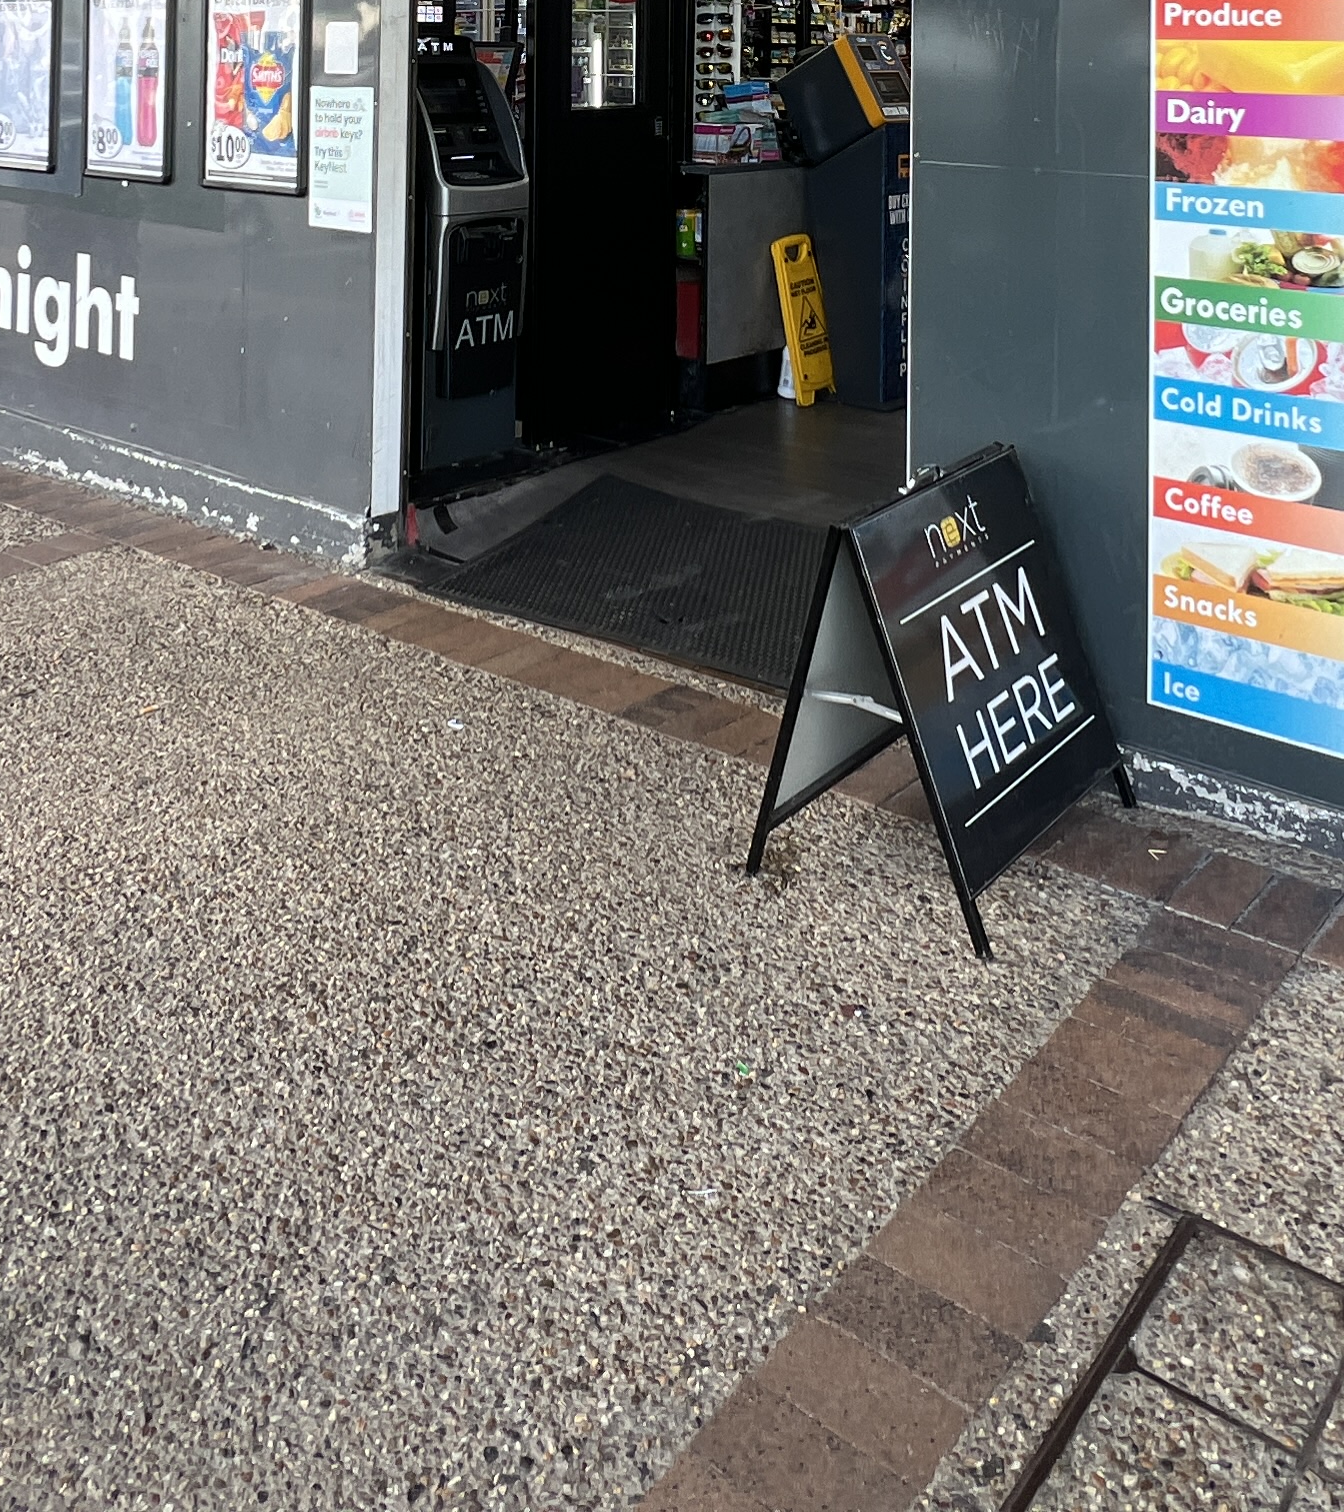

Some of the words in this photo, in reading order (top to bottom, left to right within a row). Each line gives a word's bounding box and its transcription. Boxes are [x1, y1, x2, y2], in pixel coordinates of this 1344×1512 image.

[1163, 1, 1283, 30] Produce
[315, 113, 323, 123] to
[324, 113, 342, 124] hold
[344, 116, 362, 128] your
[1166, 99, 1246, 133] Dairy
[314, 146, 326, 159] Try
[328, 146, 343, 157] this
[1166, 188, 1266, 220] Frozen
[1160, 287, 1303, 330] Groceries
[455, 310, 515, 350] ATM
[1161, 386, 1222, 420] Cold
[1231, 398, 1324, 435] Drinks
[924, 495, 986, 559] next
[1164, 486, 1255, 528] Coffee
[1163, 585, 1258, 629] Snacks
[940, 566, 1045, 703] ATM
[1163, 672, 1200, 703] Ice
[955, 654, 1076, 789] HERE
